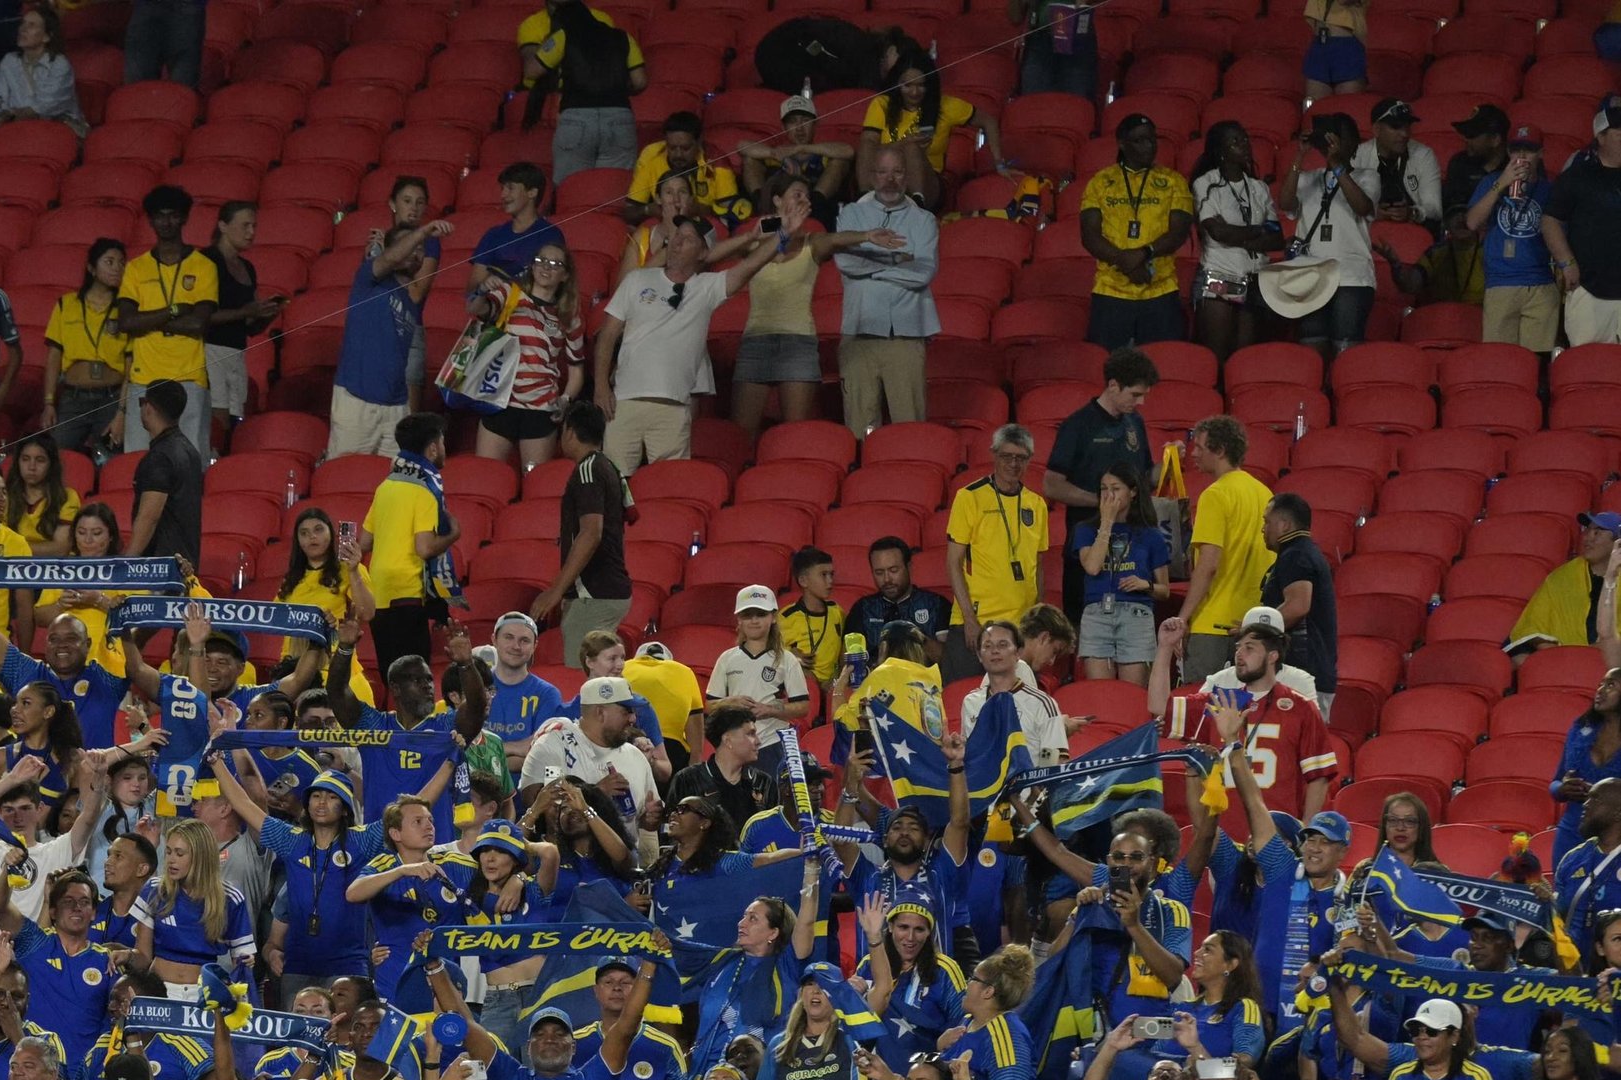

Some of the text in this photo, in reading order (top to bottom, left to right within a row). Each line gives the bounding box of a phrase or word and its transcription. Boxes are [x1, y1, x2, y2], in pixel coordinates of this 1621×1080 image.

[128, 563, 150, 574] NOS
[152, 563, 169, 574] TEI
[131, 603, 155, 614] BLOU
[288, 610, 309, 622] NOS
[310, 613, 326, 626] TE
[399, 750, 422, 769] 12
[1499, 892, 1522, 909] NOS
[443, 925, 673, 958] TEAM IS CURA
[1385, 966, 1460, 998] TEAM
[1463, 980, 1495, 1000] IS
[146, 1006, 171, 1018] BLOU
[180, 1005, 295, 1039] KOSOU
